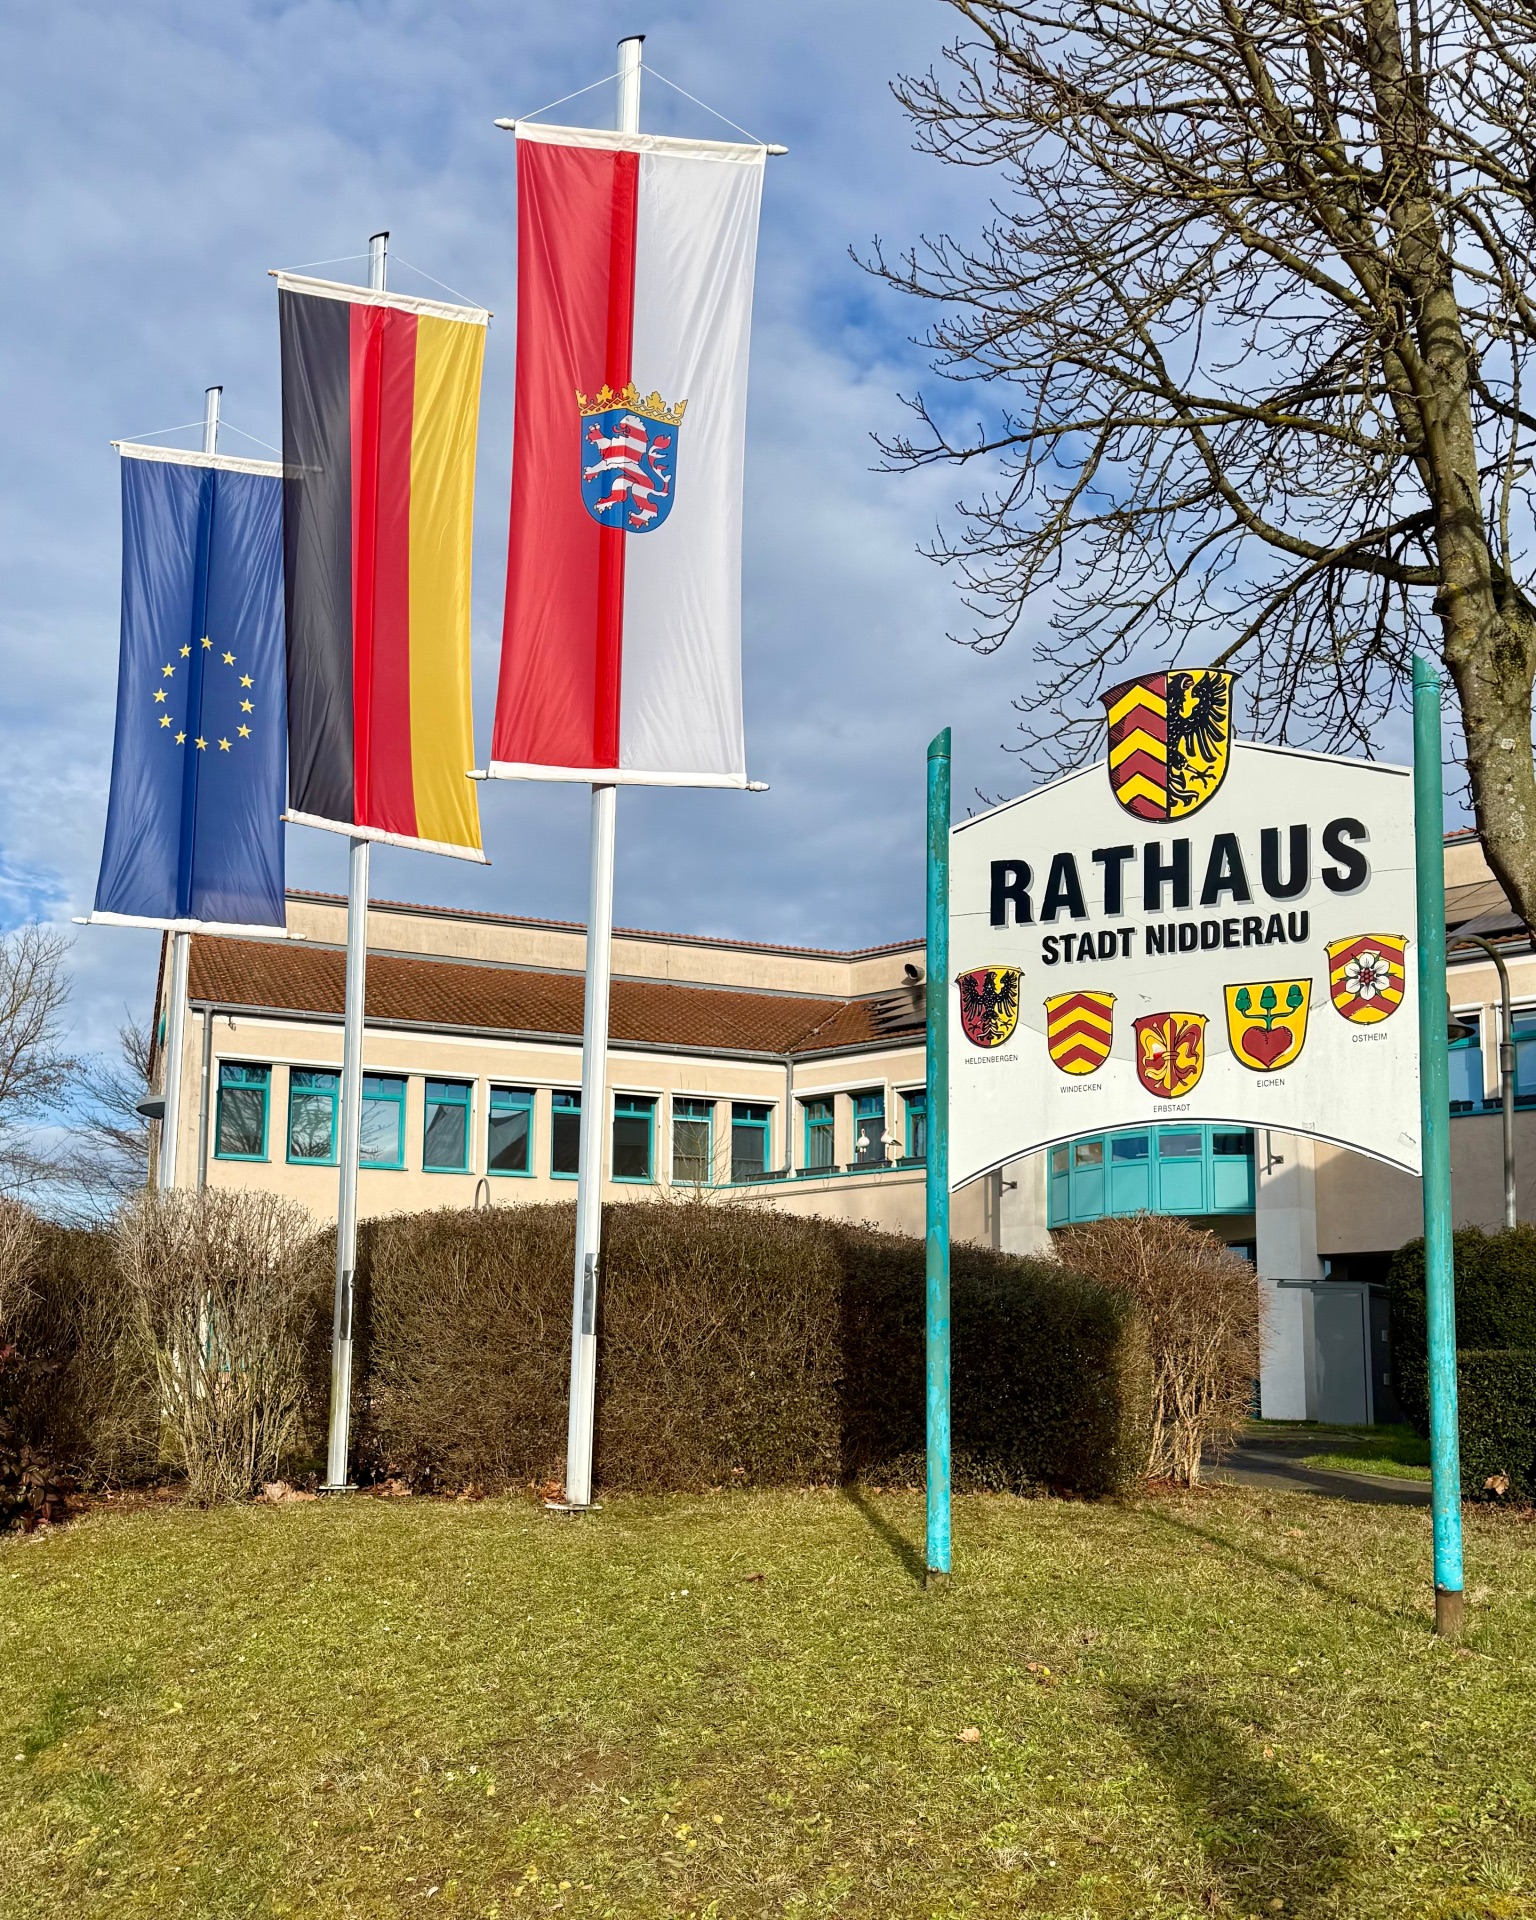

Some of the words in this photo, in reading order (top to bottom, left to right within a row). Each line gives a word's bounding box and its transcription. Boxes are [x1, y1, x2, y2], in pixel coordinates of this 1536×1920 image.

[990, 817, 1369, 926] RATHAUS
[1041, 927, 1136, 966] STADT
[1145, 910, 1309, 955] NIDDERAU
[1351, 1032, 1388, 1043] OSTHEIM
[964, 1054, 1018, 1065] HELDENBERGEN
[1060, 1083, 1102, 1094] WINDECKEN
[1256, 1078, 1285, 1088] EICHEN
[1153, 1103, 1191, 1113] ERBSTADT
